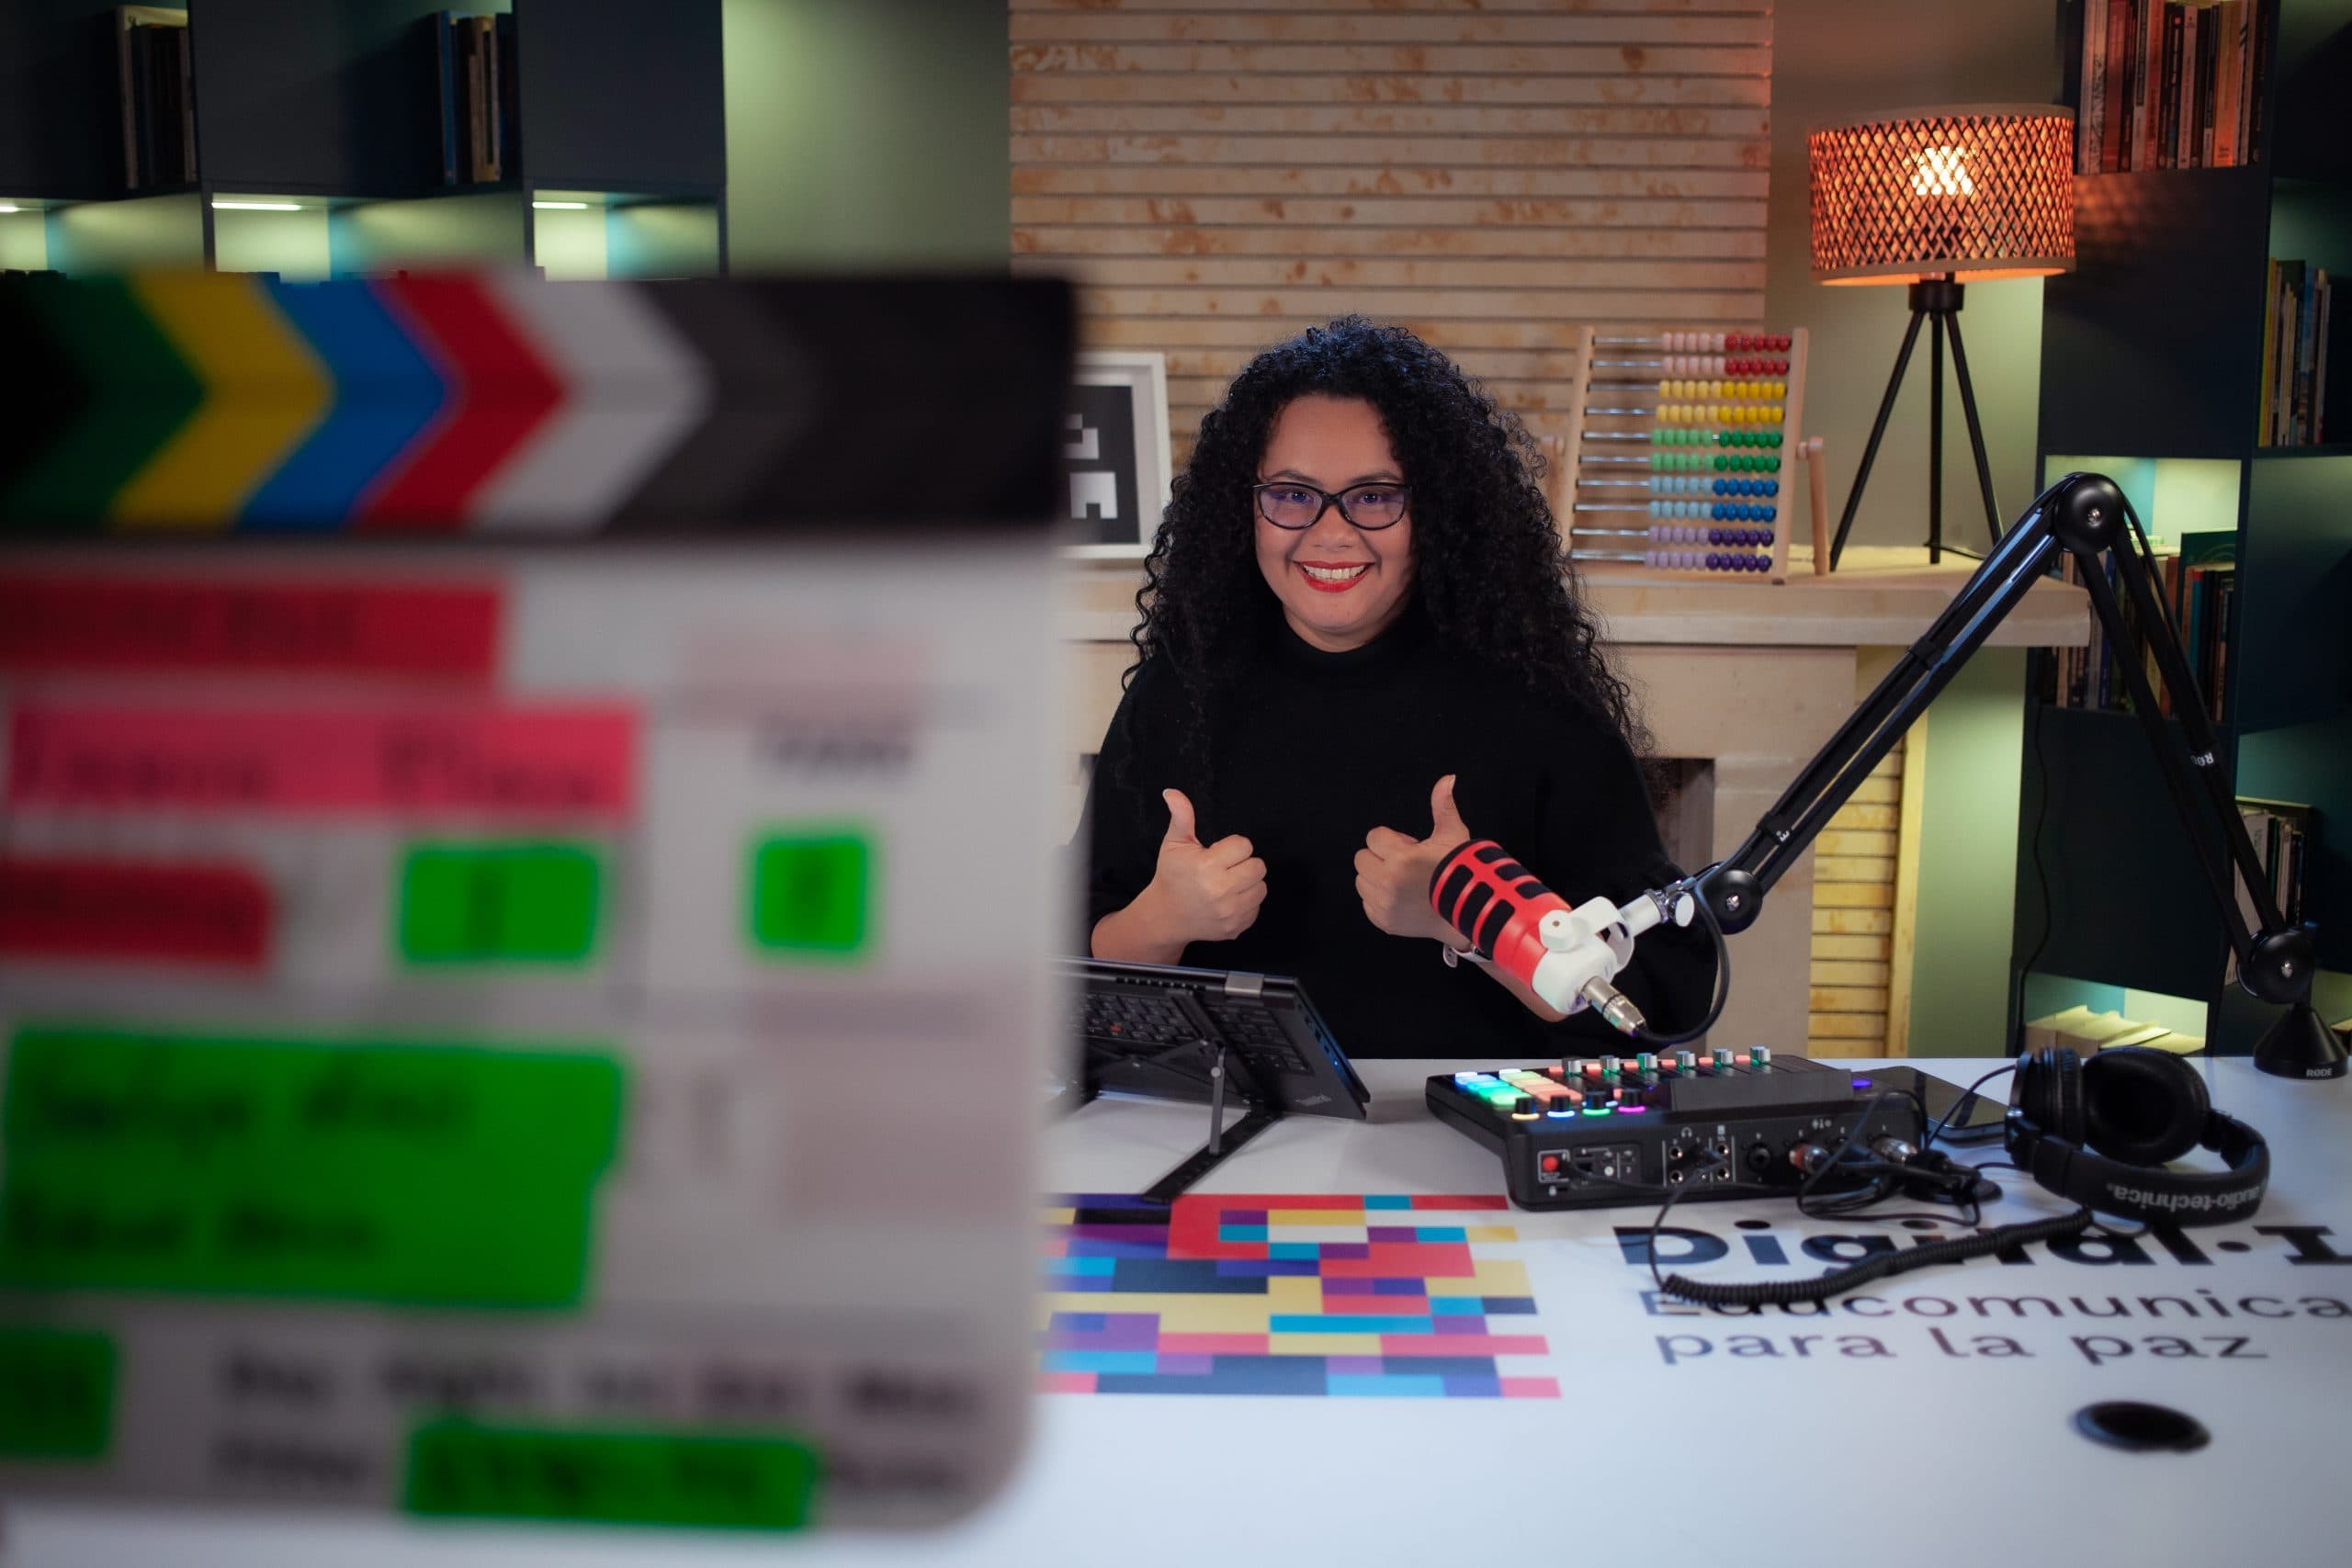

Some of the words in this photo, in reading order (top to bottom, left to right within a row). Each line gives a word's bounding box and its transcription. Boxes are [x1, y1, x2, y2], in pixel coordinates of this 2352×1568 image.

[1656, 1335, 1897, 1365] para
[1928, 1327, 2037, 1358] la
[2069, 1335, 2269, 1366] paz
